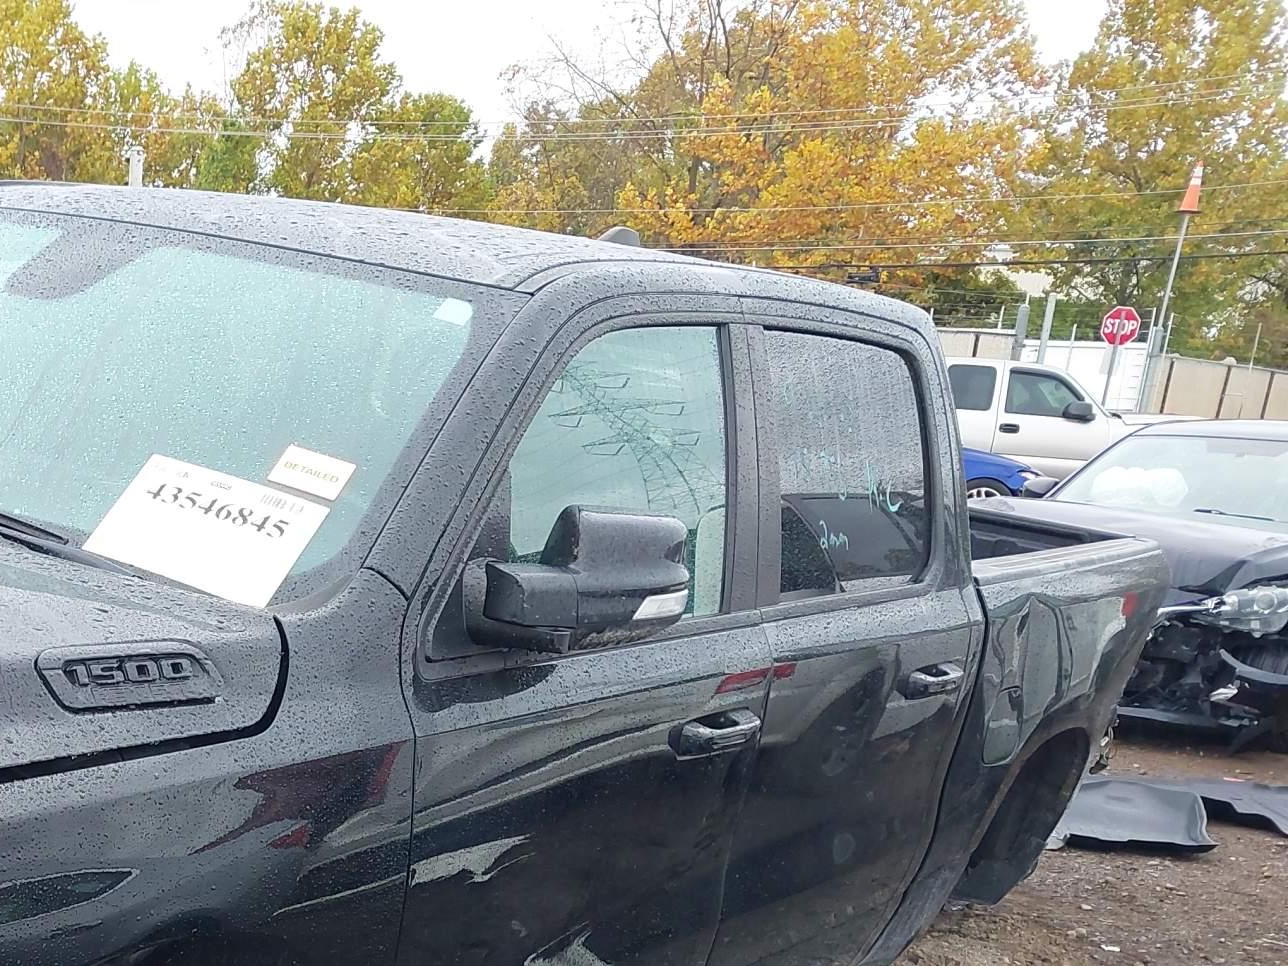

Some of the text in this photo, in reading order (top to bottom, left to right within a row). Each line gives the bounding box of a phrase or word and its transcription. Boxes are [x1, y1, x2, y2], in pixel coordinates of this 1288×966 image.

[1104, 318, 1137, 335] STOP
[284, 461, 340, 483] DETAILED
[146, 483, 289, 538] 43546845
[65, 657, 193, 687] 1500
